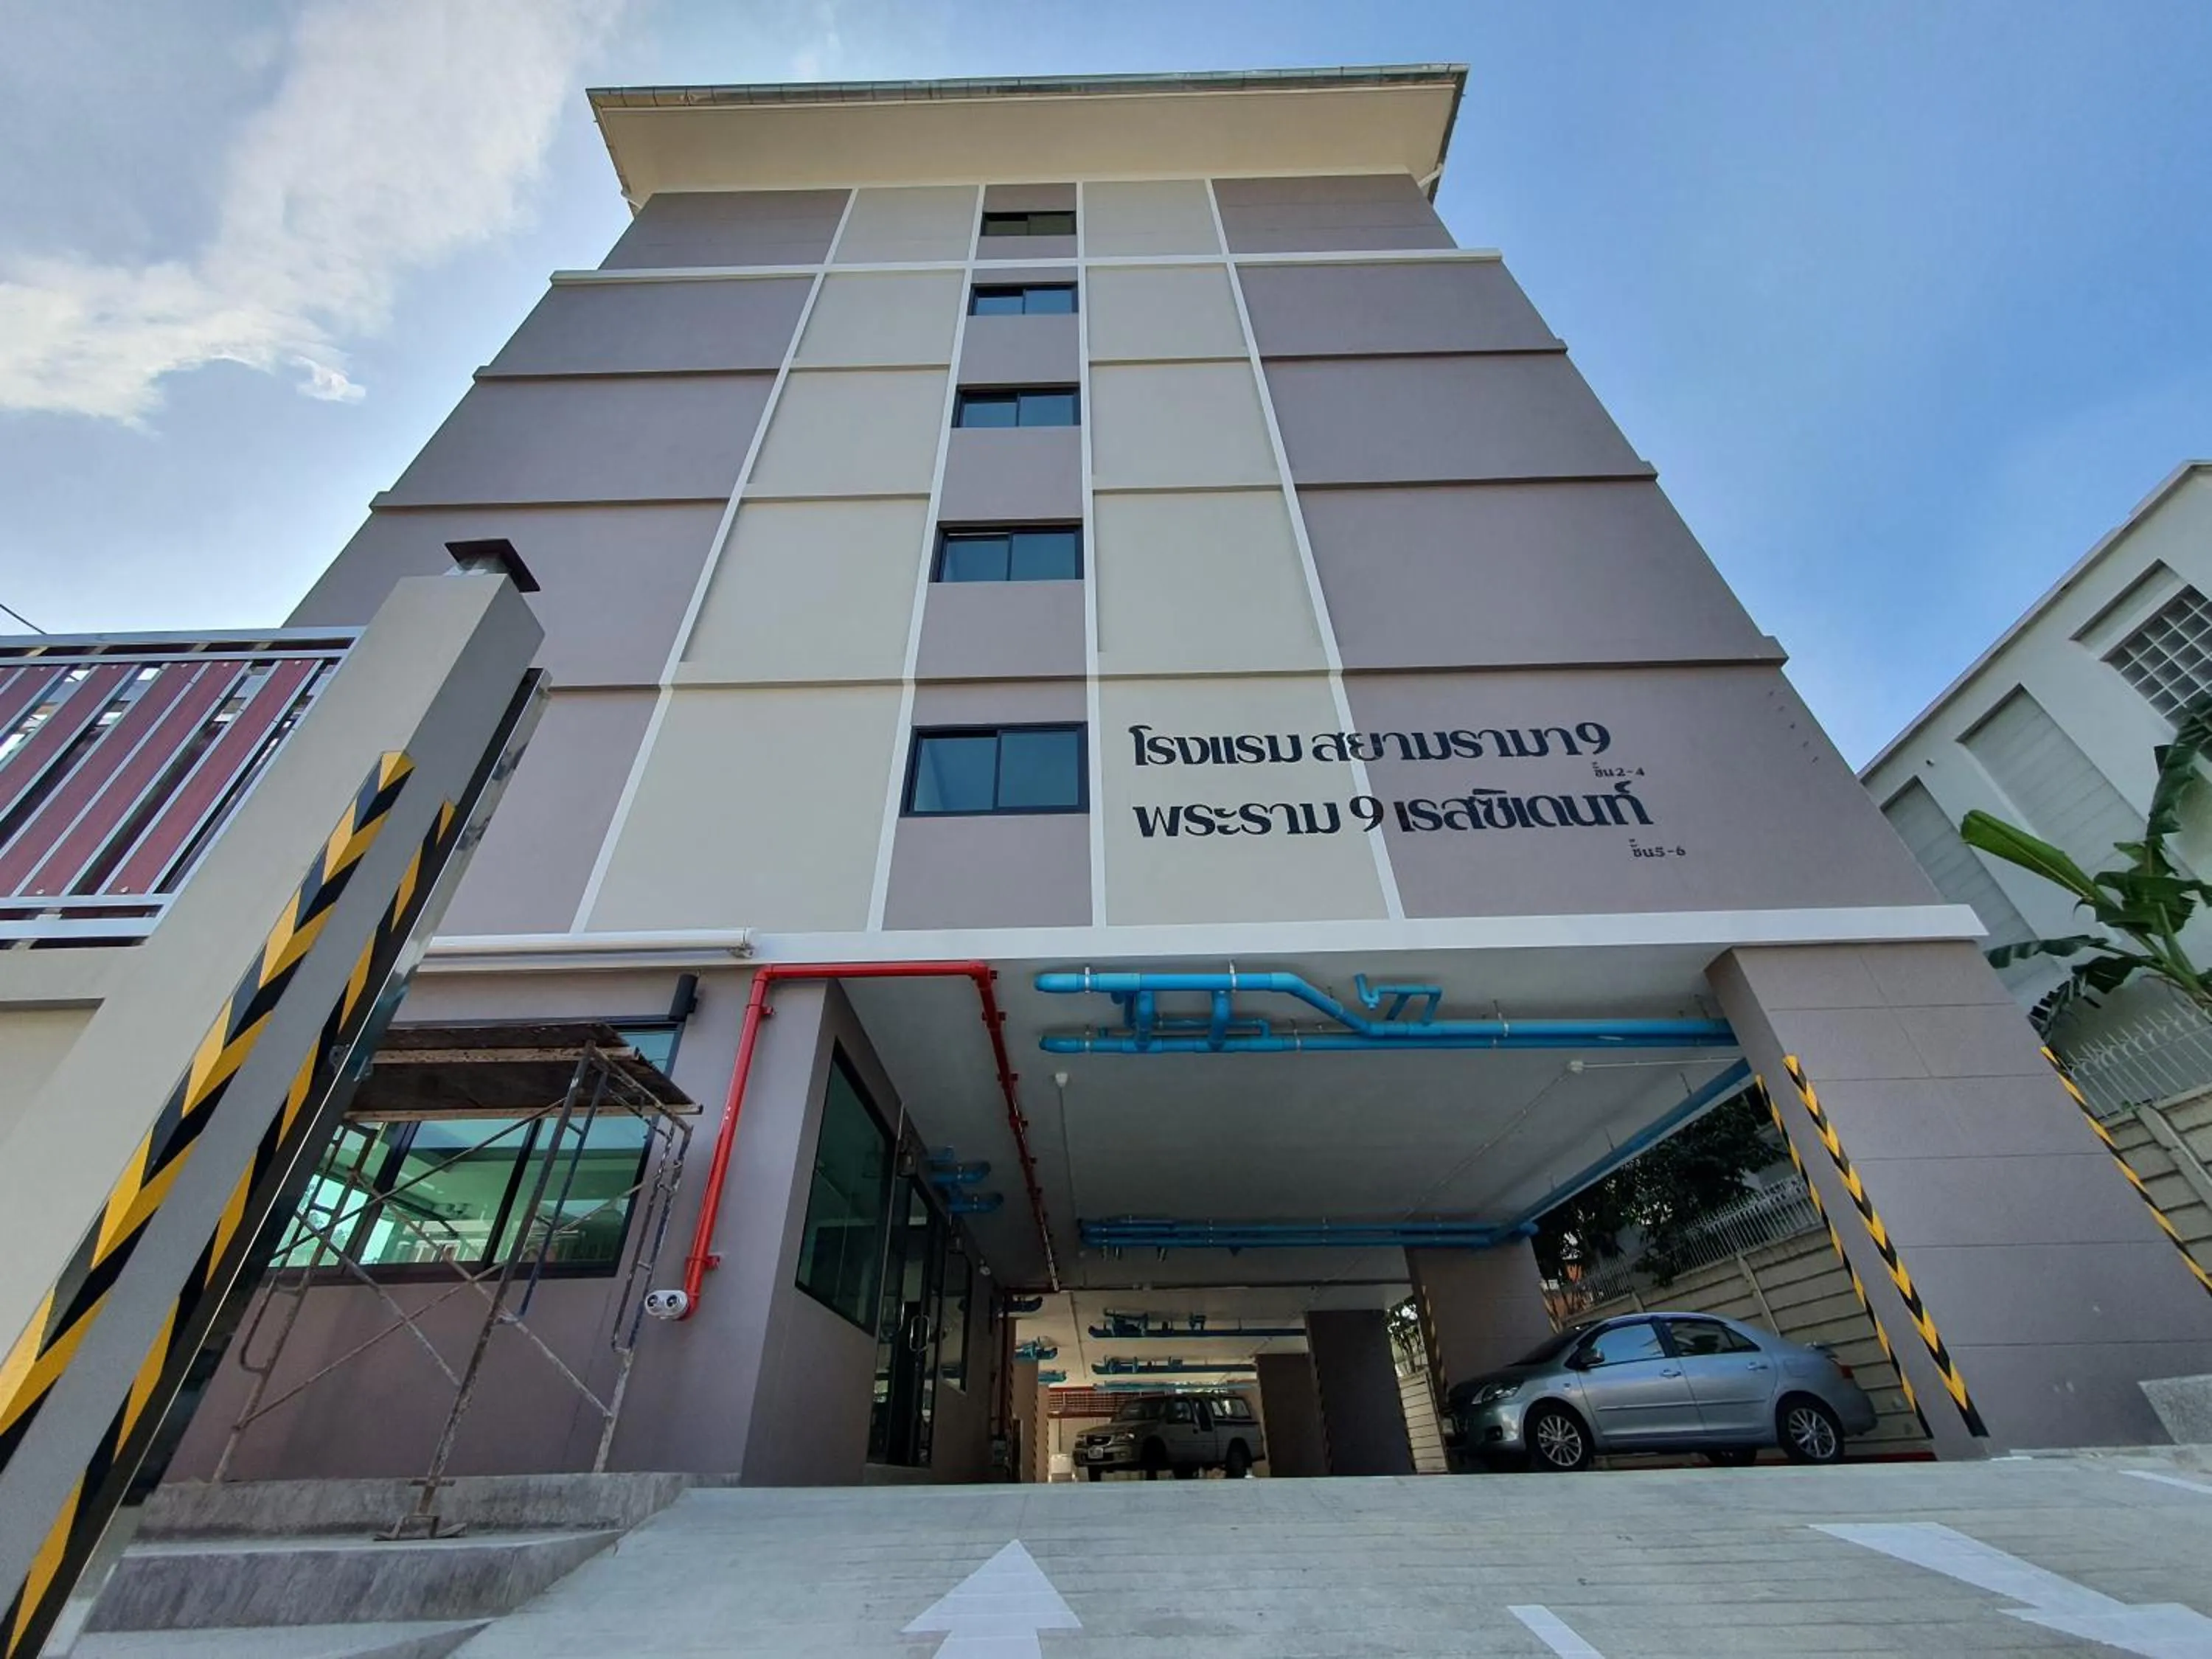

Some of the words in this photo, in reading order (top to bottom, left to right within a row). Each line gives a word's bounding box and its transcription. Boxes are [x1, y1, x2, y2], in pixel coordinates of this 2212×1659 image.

[1128, 725, 1303, 766] โรงแรม
[1133, 802, 1341, 838] พระราม
